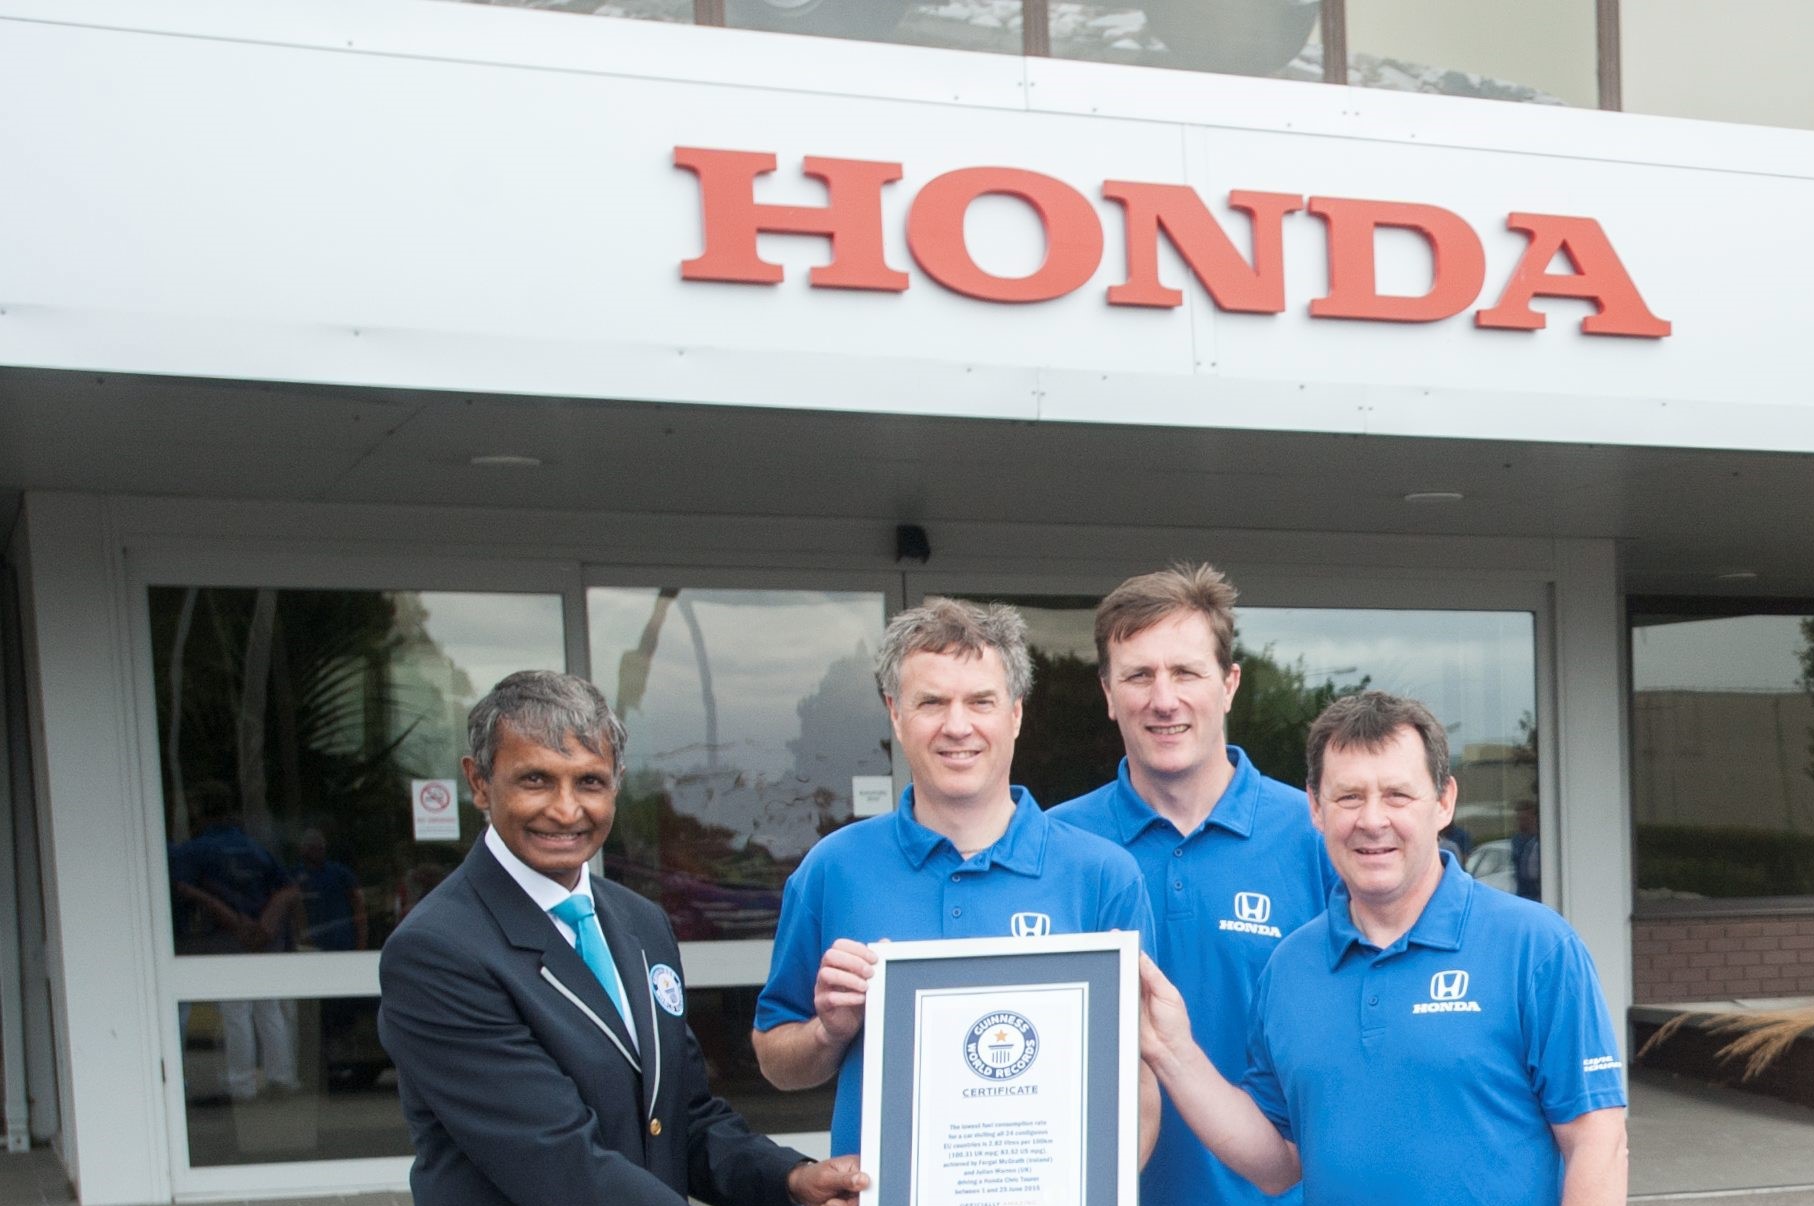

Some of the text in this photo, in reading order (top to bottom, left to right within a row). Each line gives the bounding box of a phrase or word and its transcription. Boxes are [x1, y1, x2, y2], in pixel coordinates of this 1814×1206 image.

[672, 145, 1673, 340] HONDA
[1219, 920, 1282, 938] HONDA
[1413, 1001, 1481, 1014] HONDA
[974, 1014, 1029, 1036] GUINNESS
[967, 1039, 1035, 1078] WORLD RECORDS
[962, 1085, 1038, 1098] CERTIFICATE
